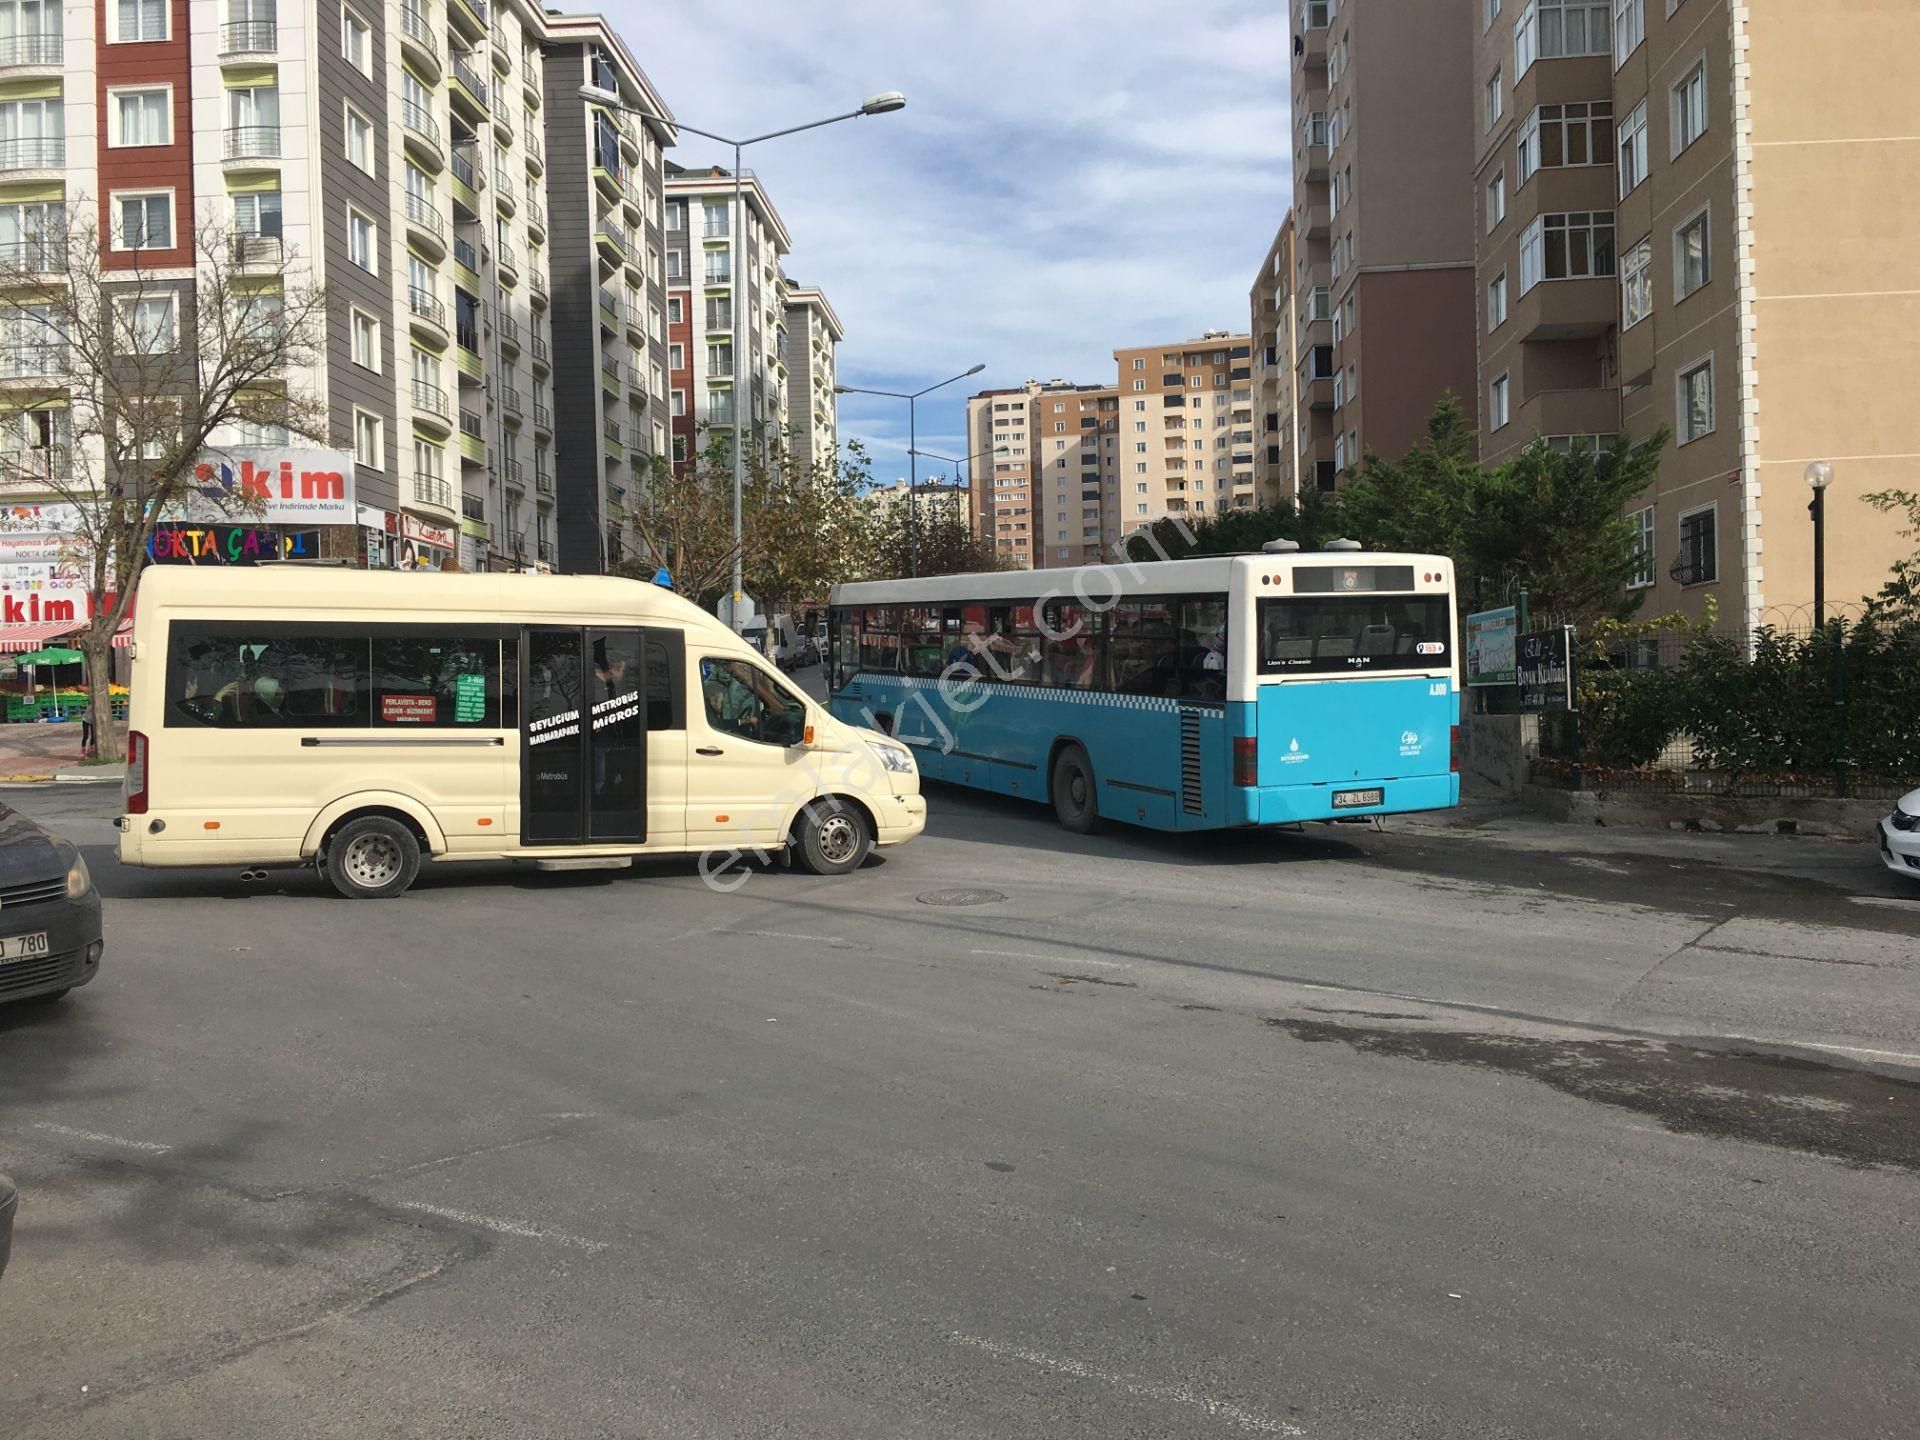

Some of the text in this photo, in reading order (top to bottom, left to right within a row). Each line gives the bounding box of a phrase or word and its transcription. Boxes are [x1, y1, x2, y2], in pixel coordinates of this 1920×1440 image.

[240, 461, 345, 500] kim
[318, 503, 345, 511] Marka
[15, 550, 40, 559] NOKTA
[148, 526, 306, 562] OKTA ÇAI
[4, 592, 75, 623] kim
[529, 724, 580, 746] MARMARAPARK
[1337, 793, 1347, 805] 34
[18, 933, 46, 955] 780
